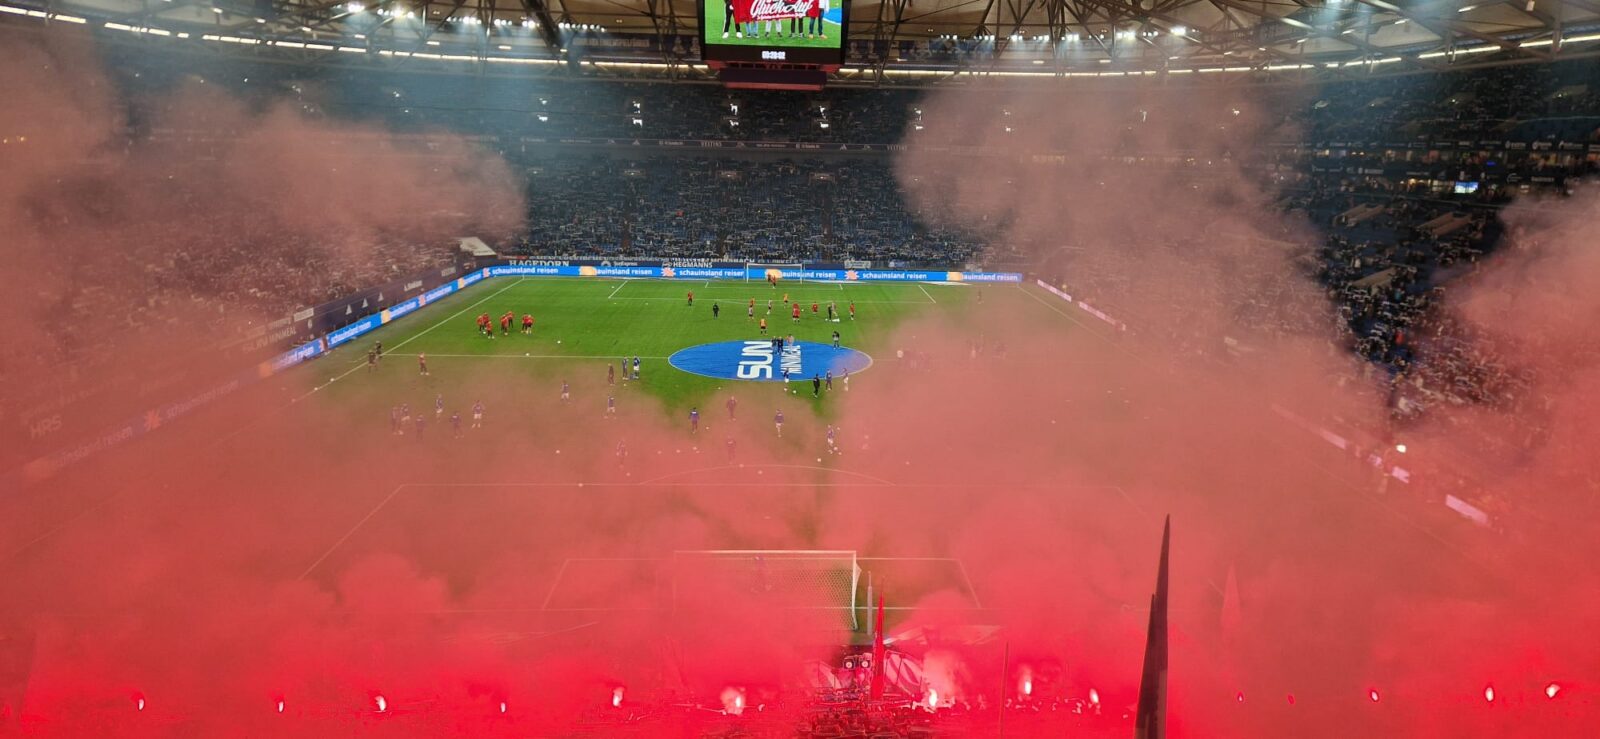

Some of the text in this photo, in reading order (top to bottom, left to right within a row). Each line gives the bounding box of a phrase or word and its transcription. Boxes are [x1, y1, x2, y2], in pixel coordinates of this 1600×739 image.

[492, 266, 536, 275] schauinsland
[679, 269, 723, 277] schauinsland
[737, 341, 773, 379] SUN
[30, 415, 62, 439] HRS
